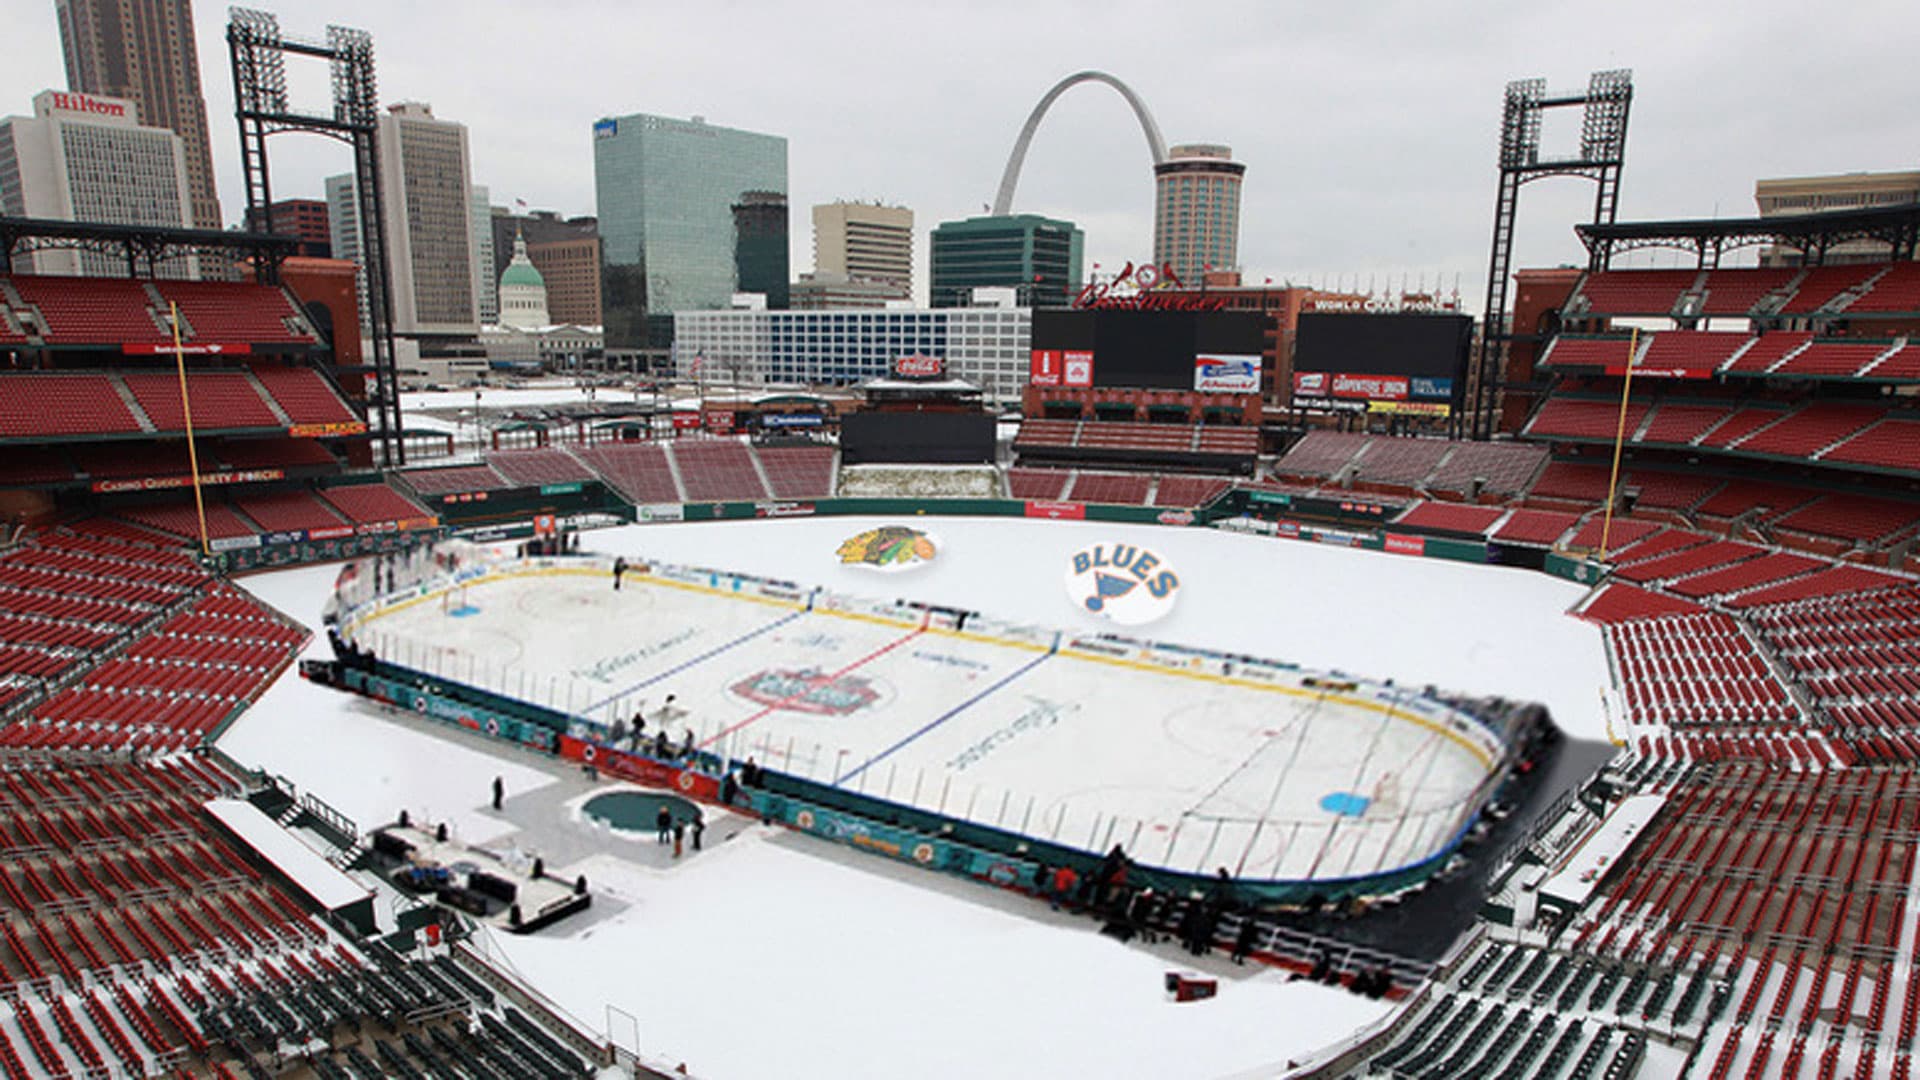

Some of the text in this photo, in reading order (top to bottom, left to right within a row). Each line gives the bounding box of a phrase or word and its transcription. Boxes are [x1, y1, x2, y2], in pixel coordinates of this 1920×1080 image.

[52, 92, 125, 117] Hilton
[1072, 283, 1227, 311] Budweiser
[1072, 543, 1179, 599] BLUES
